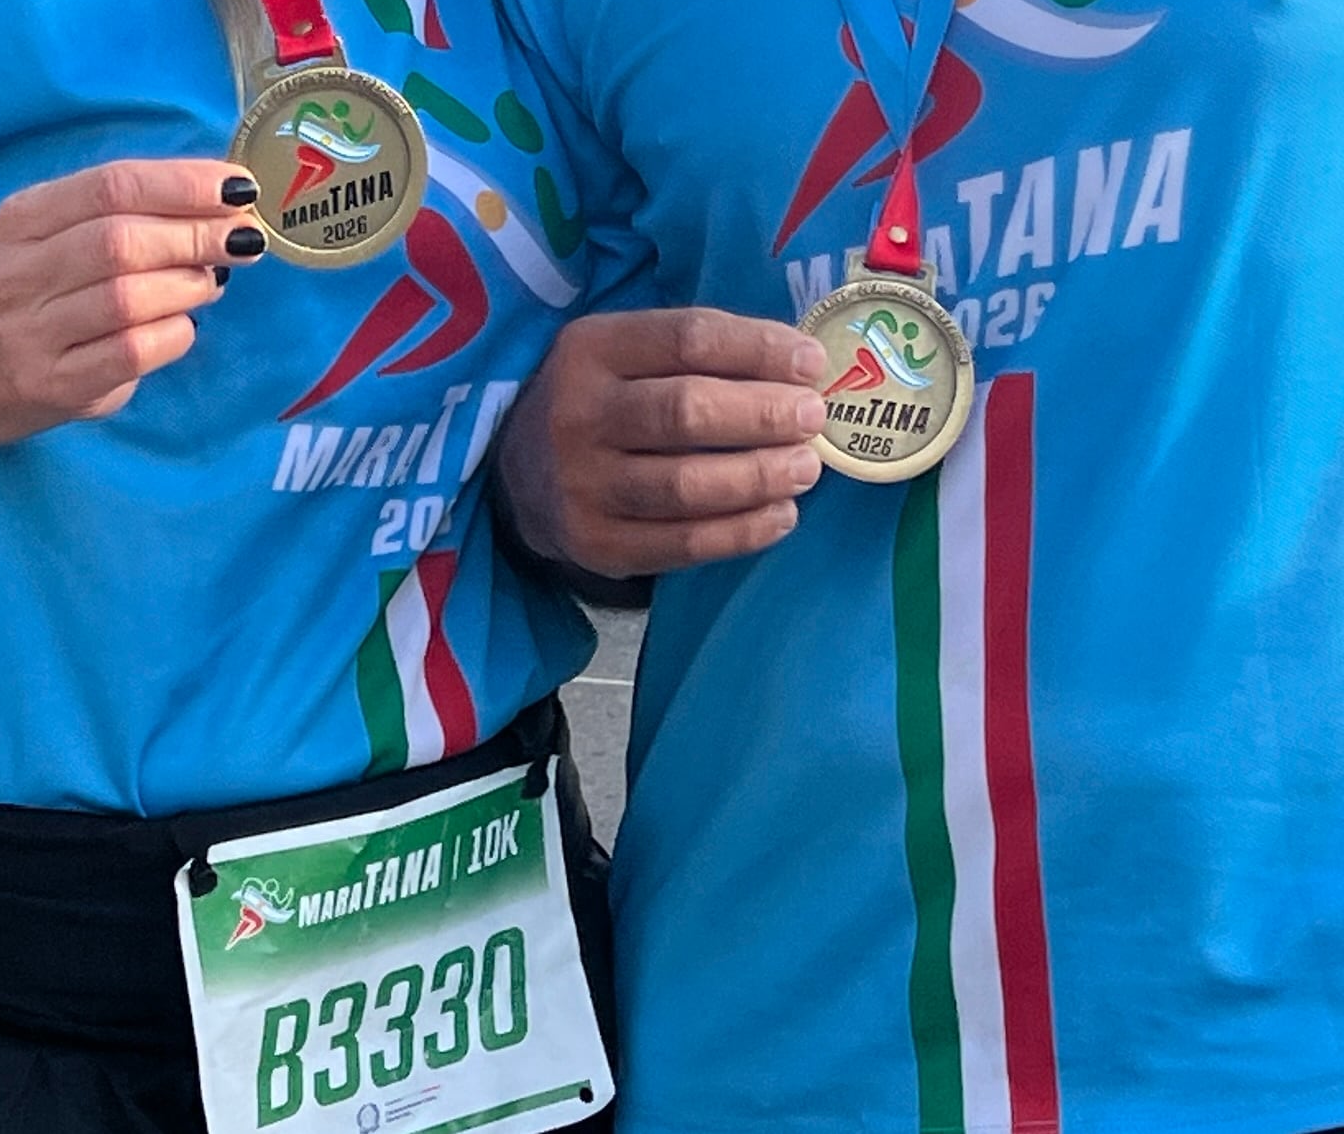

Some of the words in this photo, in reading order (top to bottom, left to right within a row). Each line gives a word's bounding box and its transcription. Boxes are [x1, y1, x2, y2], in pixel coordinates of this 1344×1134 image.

[322, 215, 368, 244] 2026
[847, 432, 895, 458] 2026
[467, 809, 520, 875] 10K
[256, 927, 528, 1129] B3330
